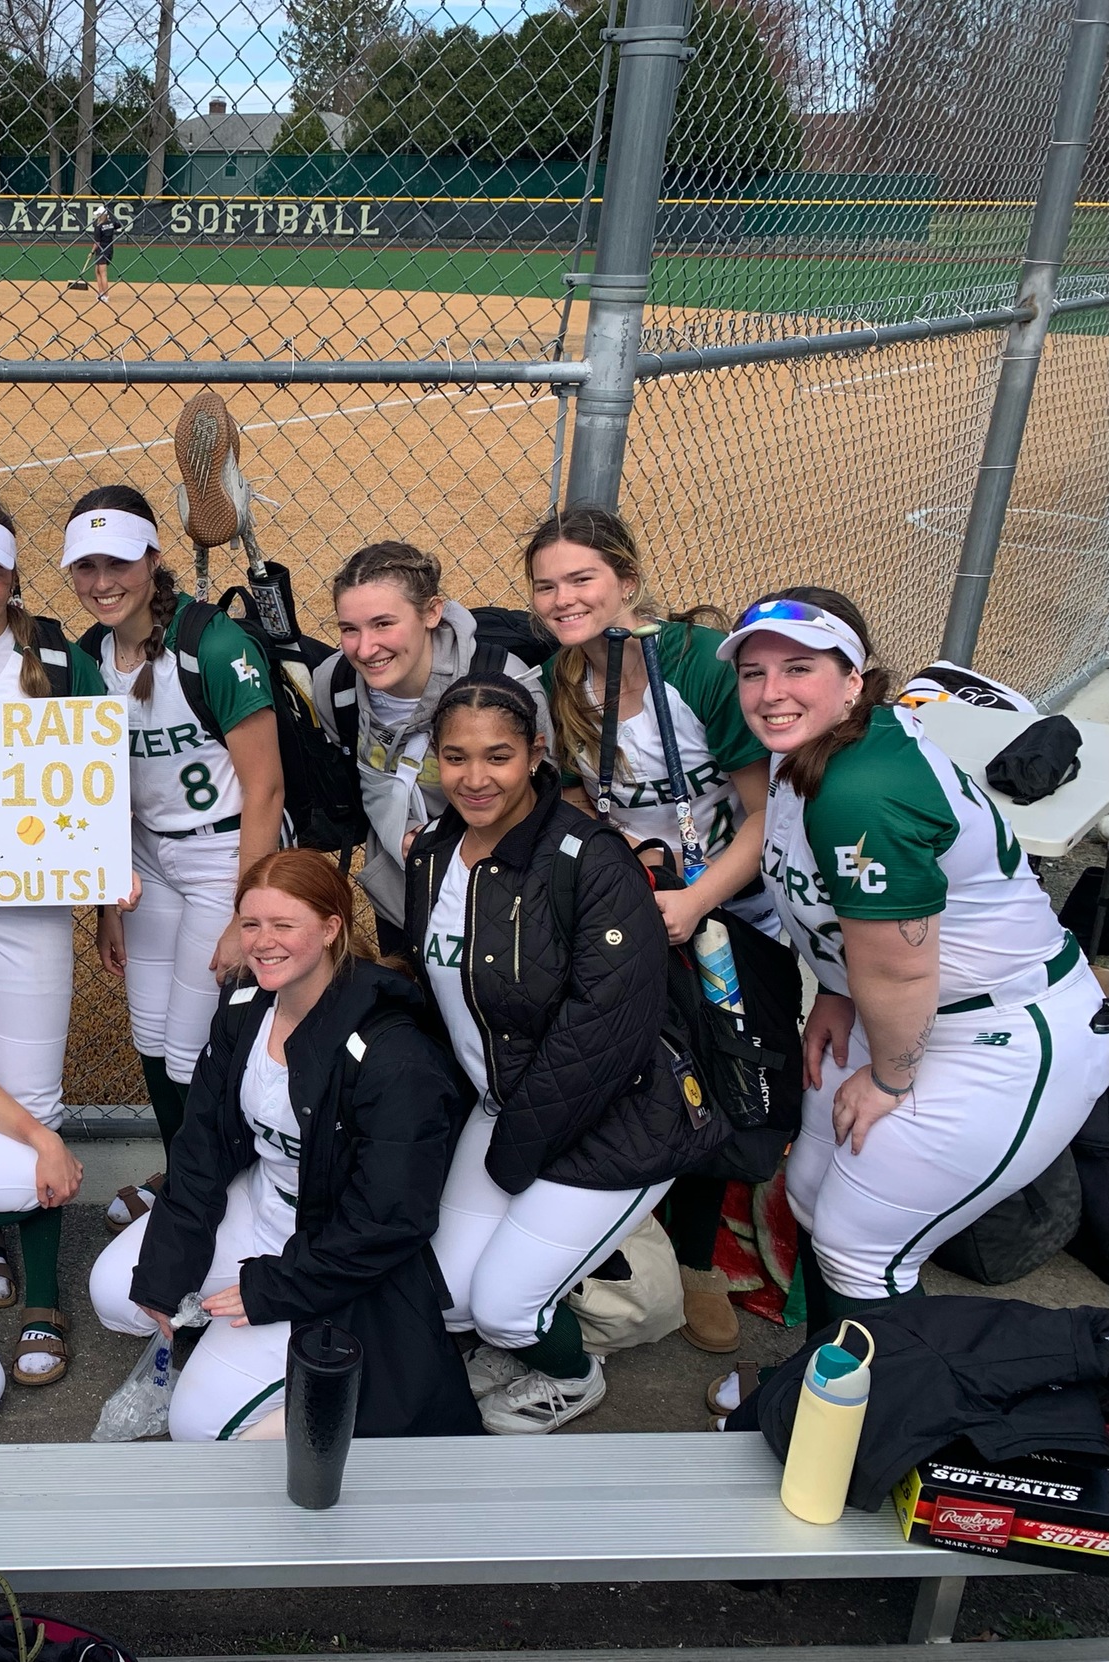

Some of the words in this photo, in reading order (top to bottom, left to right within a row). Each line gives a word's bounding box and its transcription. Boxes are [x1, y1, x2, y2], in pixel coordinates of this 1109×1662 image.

[170, 203, 380, 236] SOFTBALL
[128, 722, 219, 760] ZER
[1, 760, 116, 808] 100
[179, 761, 220, 812] 8
[834, 845, 887, 894] EC
[931, 1468, 1079, 1501] SOFTBALLS
[943, 1465, 981, 1475] OFFICIAL
[983, 1471, 1006, 1479] NCAA
[938, 1509, 1007, 1532] Rawlings
[1039, 1523, 1078, 1535] OFFICIAL
[1080, 1530, 1105, 1539] NCAA
[944, 1539, 969, 1549] MARK
[981, 1546, 999, 1554] PRO
[1036, 1530, 1109, 1551] SOFTB
